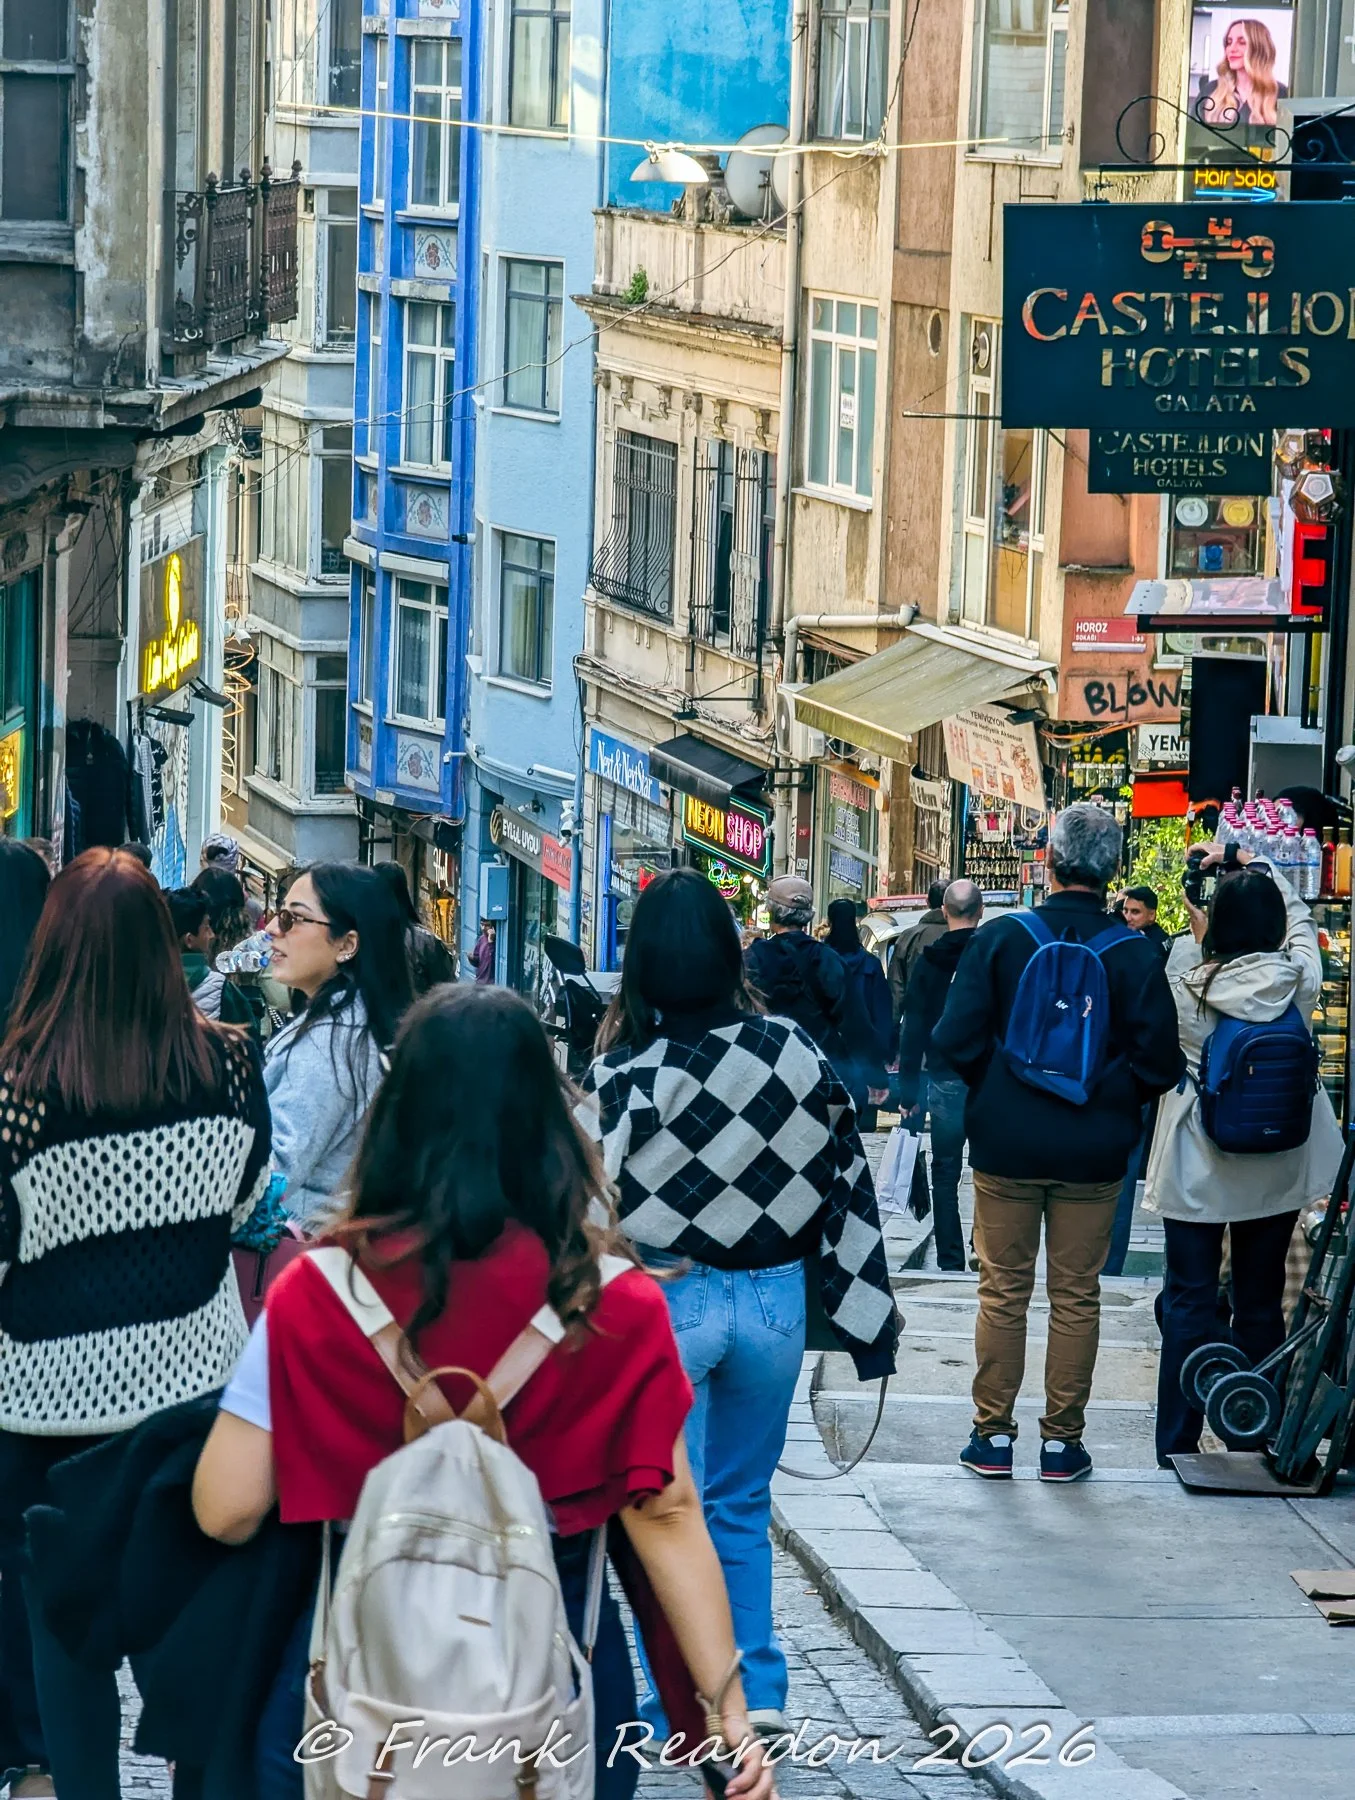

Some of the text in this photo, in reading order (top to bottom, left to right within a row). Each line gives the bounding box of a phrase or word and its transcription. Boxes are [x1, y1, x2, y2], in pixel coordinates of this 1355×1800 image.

[1194, 168, 1231, 187] Hair
[1021, 287, 1355, 341] CASTELLIO
[1101, 347, 1312, 388] HOTELS
[1155, 394, 1257, 413] GALATA
[1098, 430, 1264, 457] CASTELLION
[1133, 457, 1227, 477] HOTELS
[1156, 478, 1203, 488] GALATA
[1076, 621, 1108, 633] HOROZ
[1084, 673, 1182, 717] BLOW
[597, 739, 614, 780] Next
[613, 748, 622, 784] &
[688, 795, 762, 860] NEON SHOP
